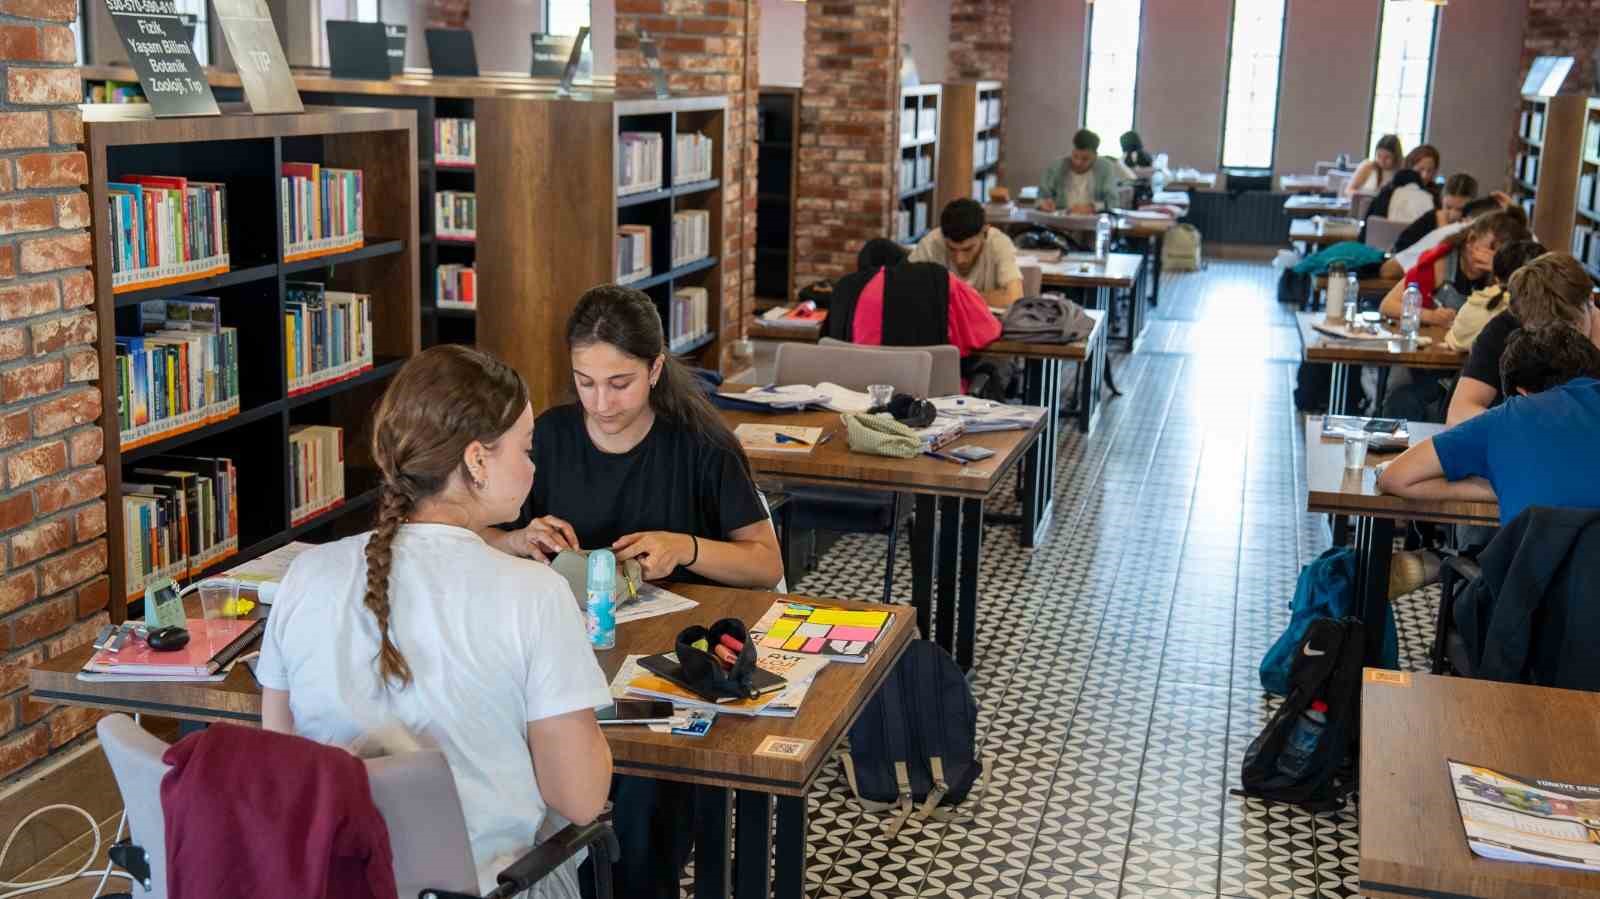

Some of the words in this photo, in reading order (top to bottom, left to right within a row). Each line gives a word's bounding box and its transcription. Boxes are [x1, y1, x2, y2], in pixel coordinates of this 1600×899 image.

[137, 20, 167, 37] Fizik,
[127, 38, 163, 56] Yaşam
[148, 58, 188, 72] Botanik
[149, 77, 188, 95] Zooloji,
[185, 78, 203, 94] Tıp
